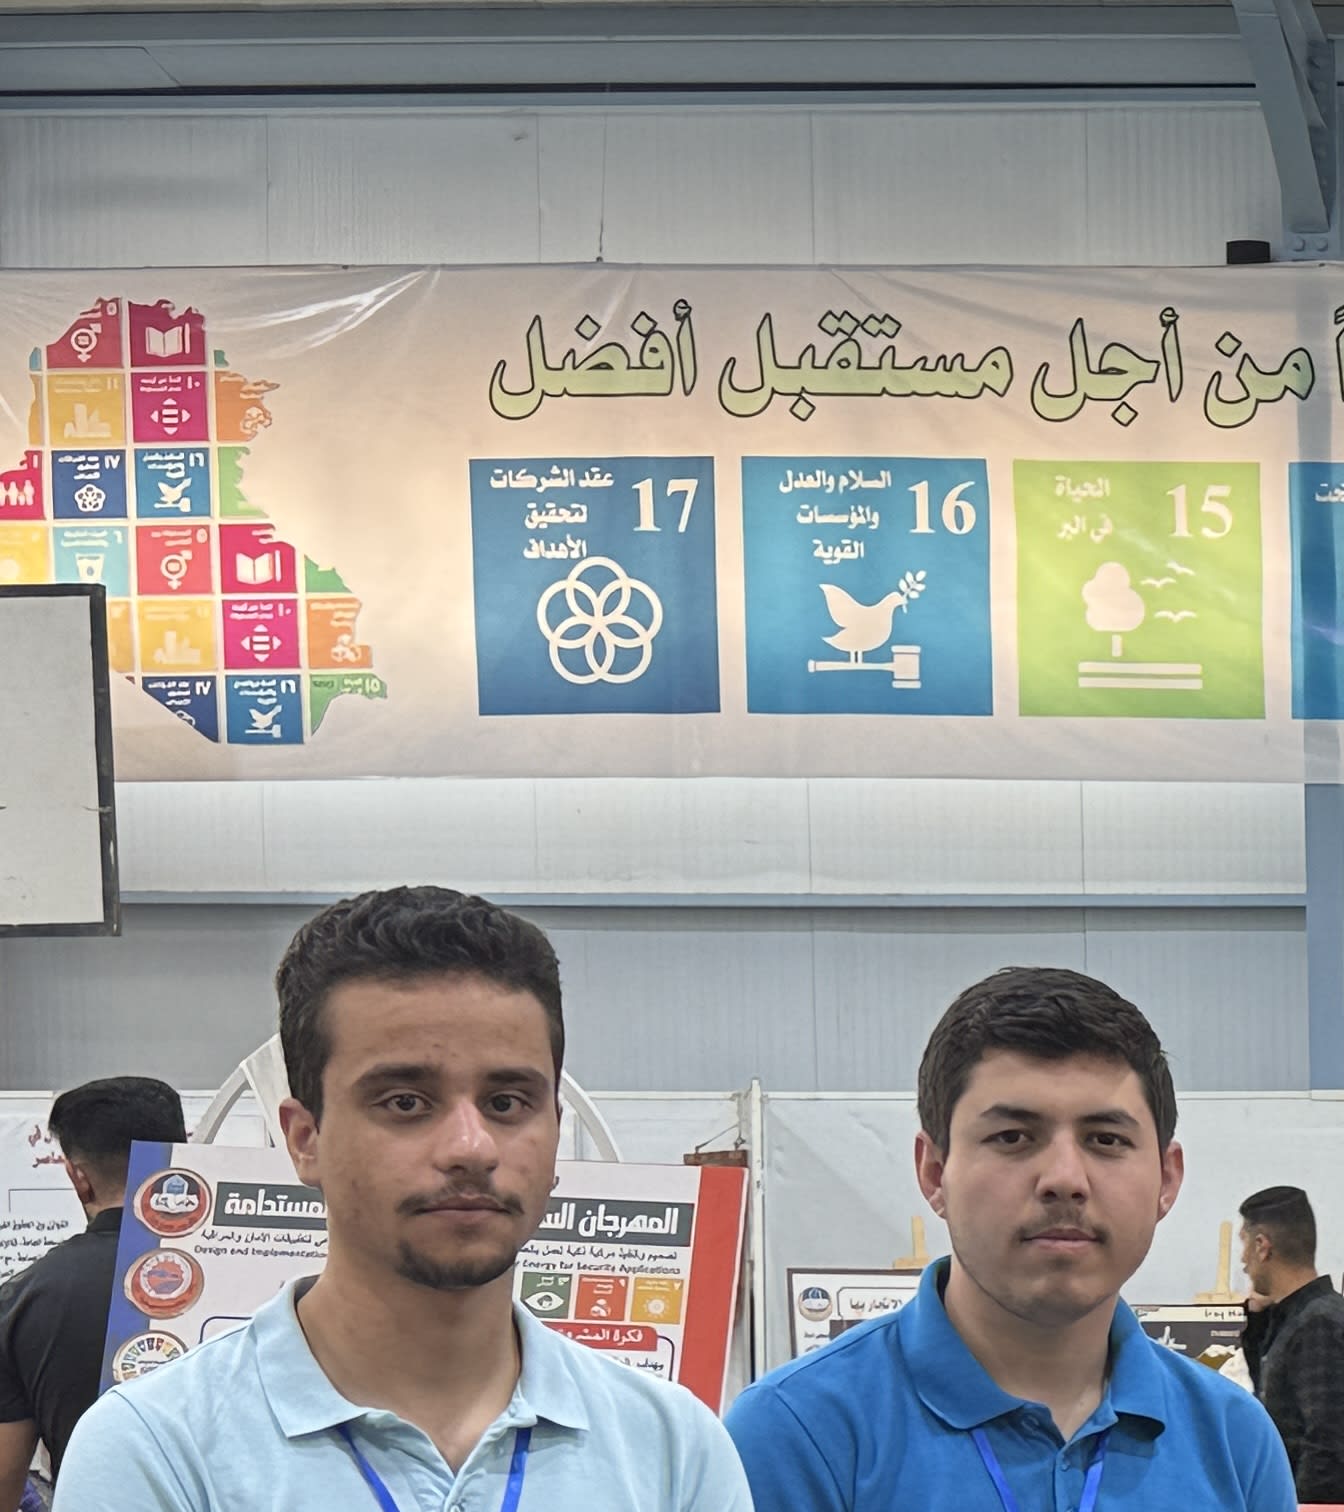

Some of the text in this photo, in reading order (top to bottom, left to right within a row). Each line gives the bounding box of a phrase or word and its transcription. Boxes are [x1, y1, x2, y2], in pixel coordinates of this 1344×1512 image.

[489, 300, 697, 419] أفضل
[718, 309, 1014, 421] مستقبل
[1030, 306, 1183, 427] أجل
[1203, 331, 1315, 429] من
[578, 466, 615, 488] عقد
[778, 470, 892, 494] السلام والعدل
[1054, 474, 1110, 503] الحياة
[631, 478, 699, 533] 17
[908, 479, 976, 536] 16
[1166, 483, 1233, 539] 15
[812, 538, 865, 565] القوية
[224, 1188, 679, 1238] المهرجان الس مستدامة
